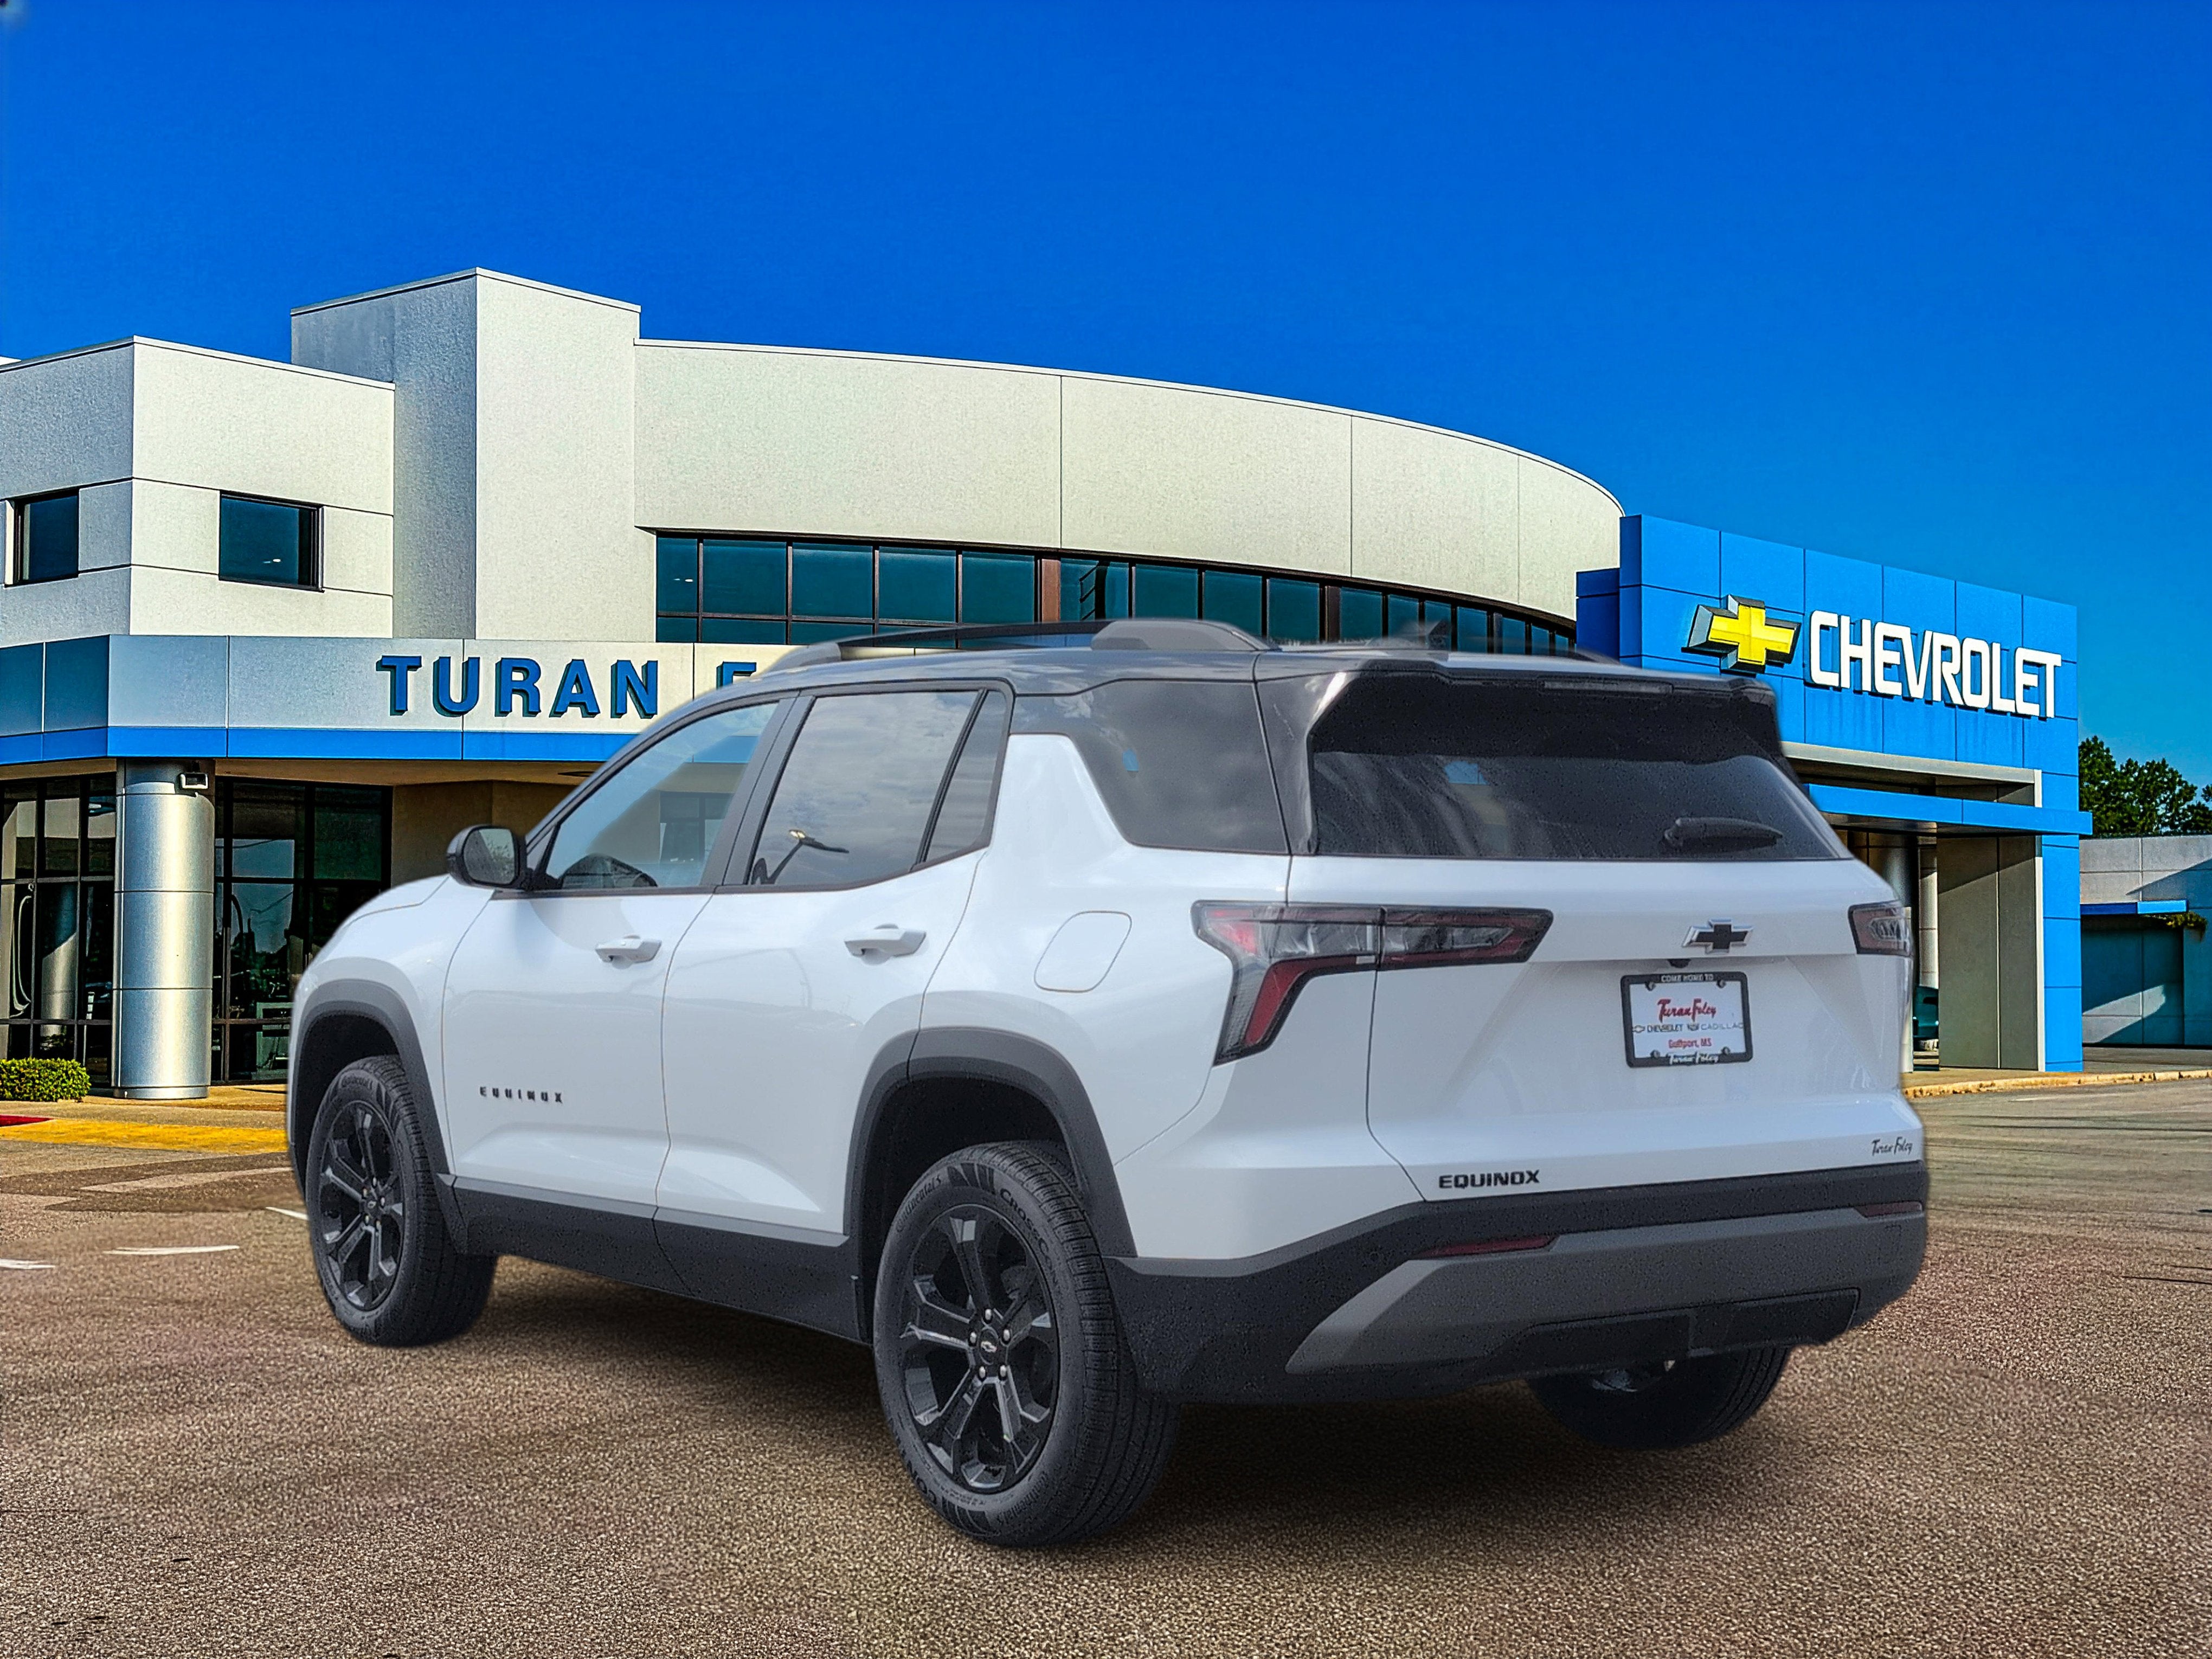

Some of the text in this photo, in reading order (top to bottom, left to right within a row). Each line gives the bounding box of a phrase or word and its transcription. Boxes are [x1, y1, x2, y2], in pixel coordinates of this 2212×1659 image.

[1809, 610, 2062, 718] CHEVROLET
[376, 655, 658, 718] TURAN
[480, 1086, 562, 1103] EQUINOX
[1439, 1170, 1540, 1189] EQUINOX
